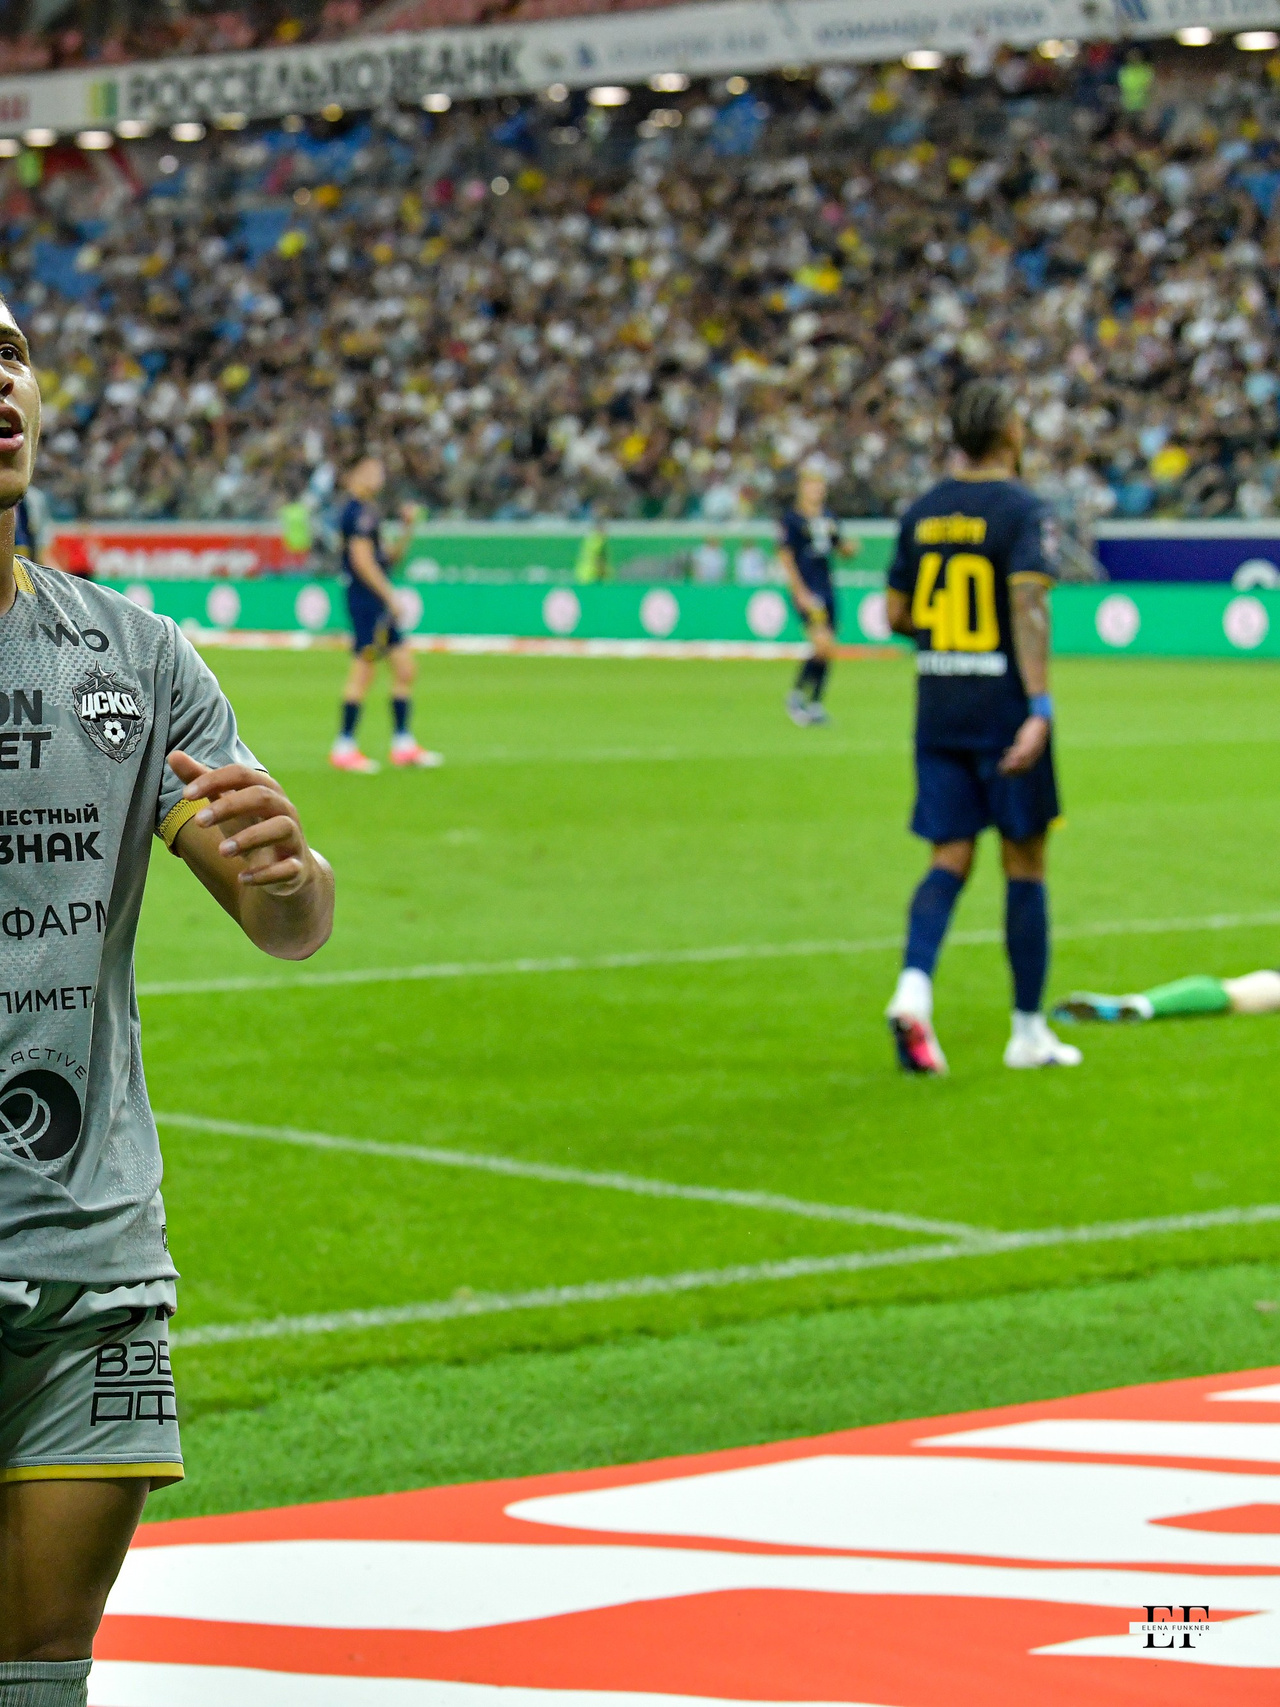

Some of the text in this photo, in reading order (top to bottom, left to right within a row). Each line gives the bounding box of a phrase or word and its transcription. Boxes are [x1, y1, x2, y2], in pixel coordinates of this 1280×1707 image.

[911, 552, 1001, 653] 40
[80, 690, 142, 722] ЦСКА
[10, 1048, 87, 1080] ACTIVE
